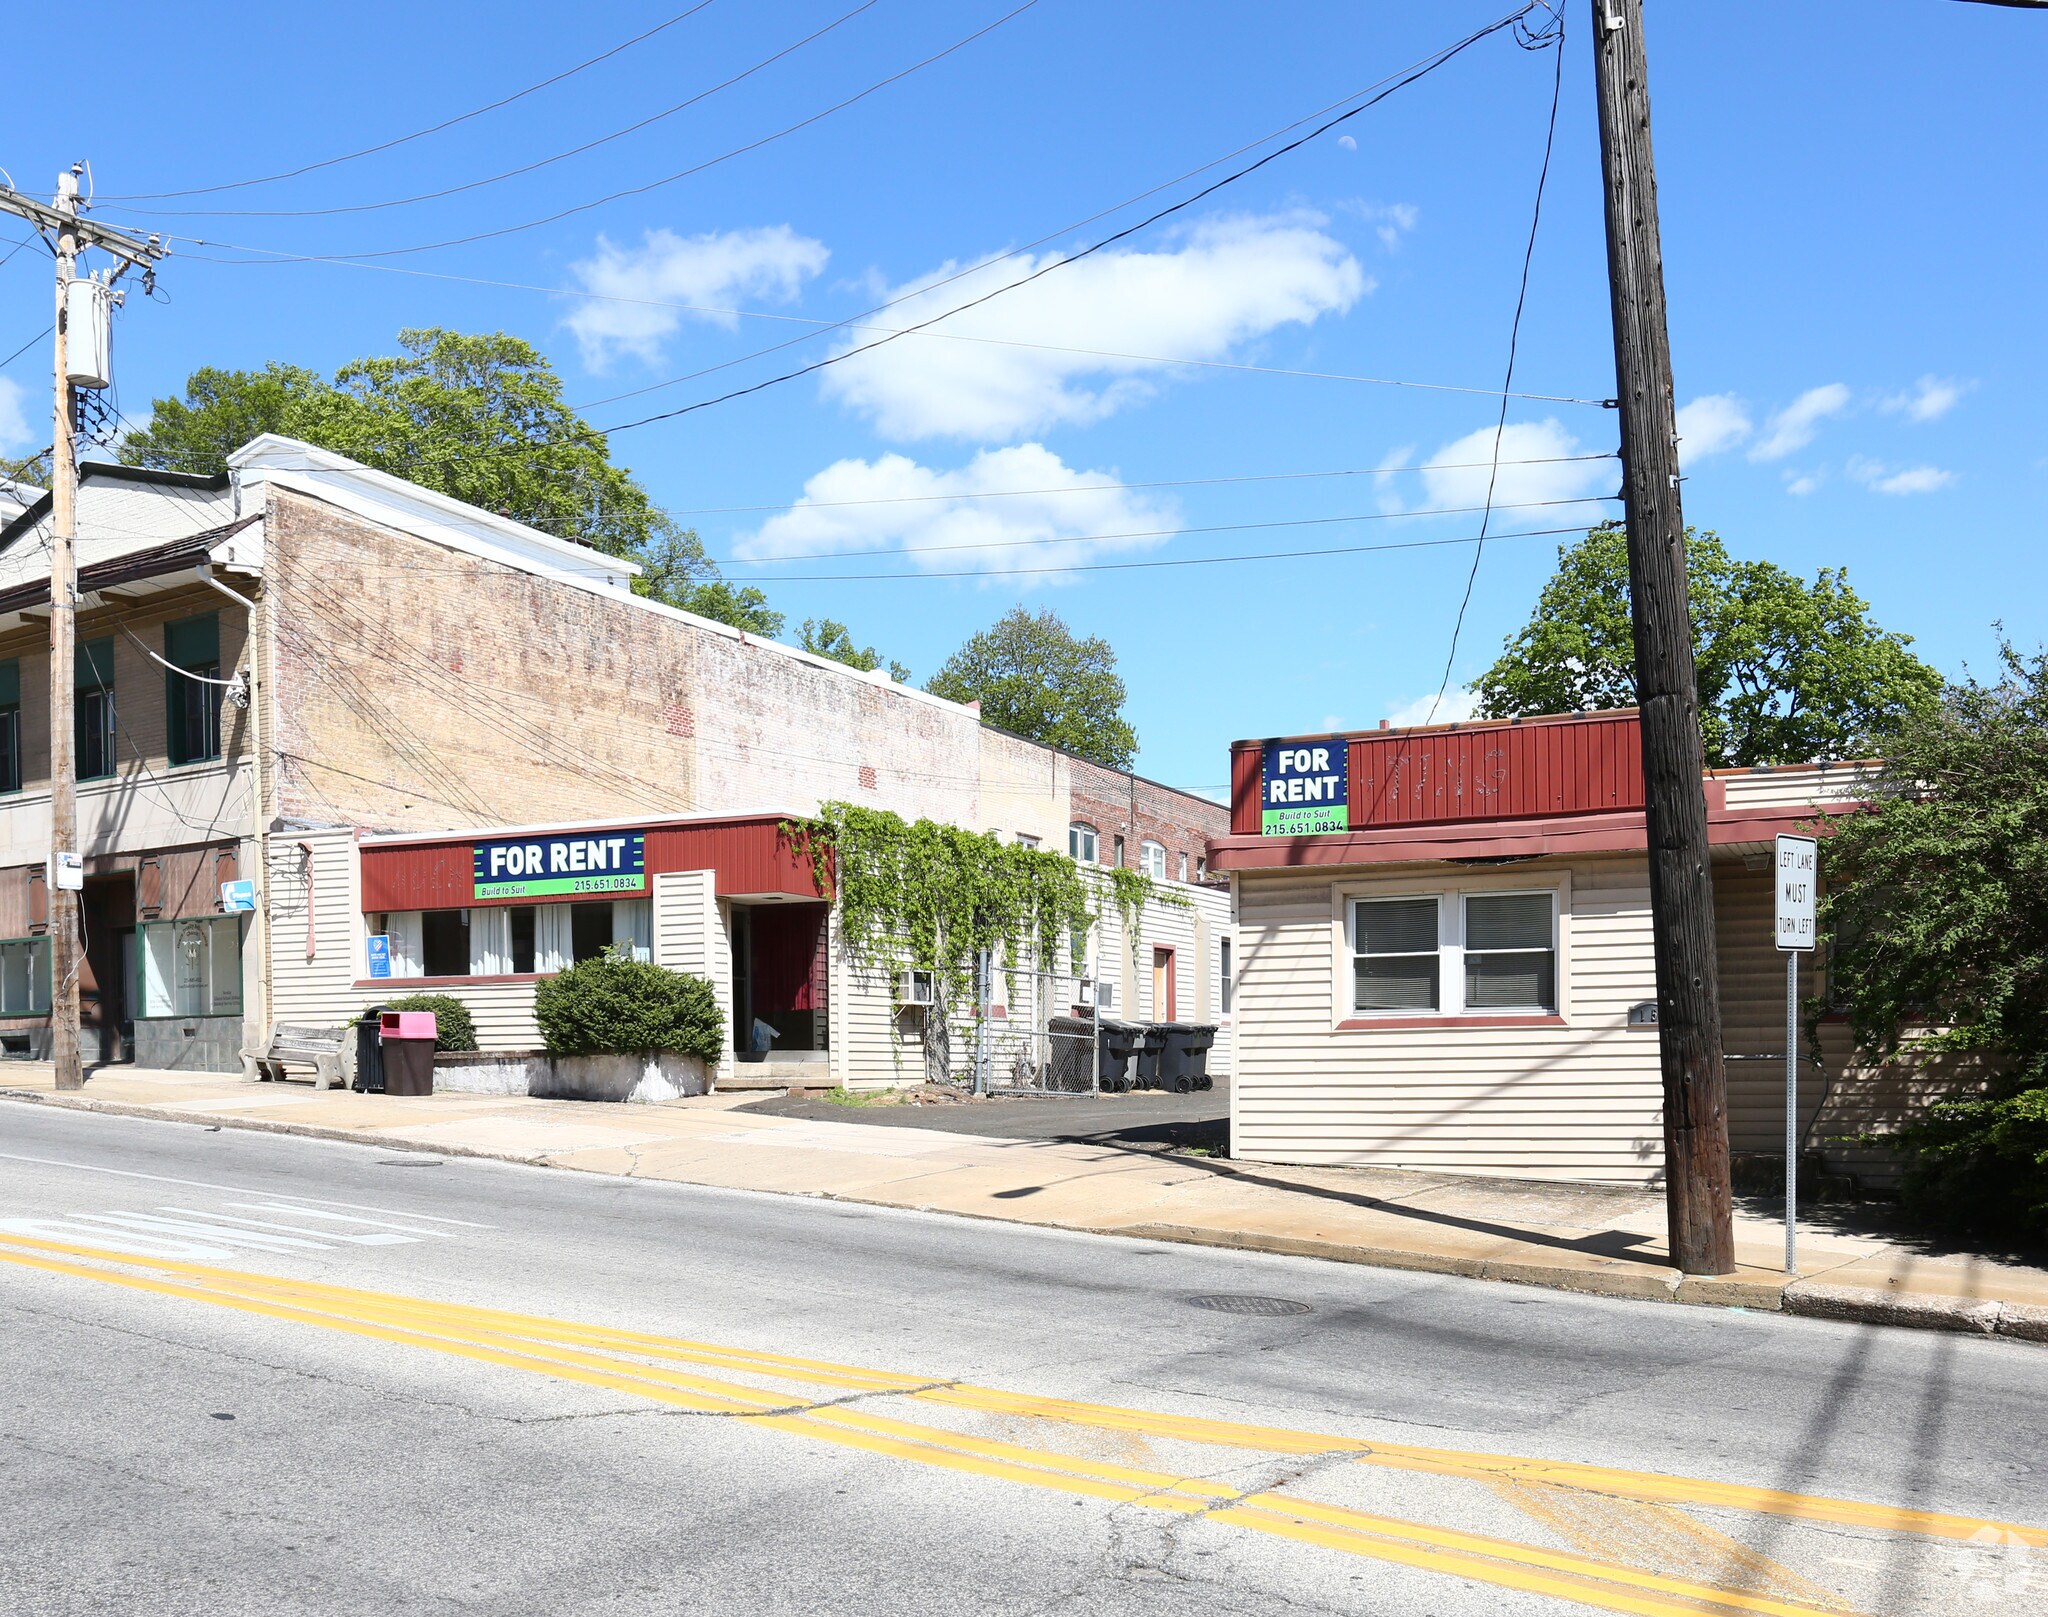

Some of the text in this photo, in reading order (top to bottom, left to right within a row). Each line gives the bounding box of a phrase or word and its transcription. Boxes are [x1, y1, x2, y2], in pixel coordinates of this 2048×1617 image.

[1279, 748, 1330, 774] FOR
[1270, 775, 1339, 803] RENT
[1279, 810, 1330, 821] Build to Suit
[1265, 821, 1343, 835] 215.651.0834
[490, 844, 544, 877] FOR
[550, 838, 626, 873] RENT
[1779, 850, 1813, 871] LEFT LANE
[481, 885, 526, 896] Build to Suit
[574, 877, 637, 891] 215.651.0834
[1785, 883, 1807, 903] MUST
[1779, 917, 1812, 934] TURN LEFT
